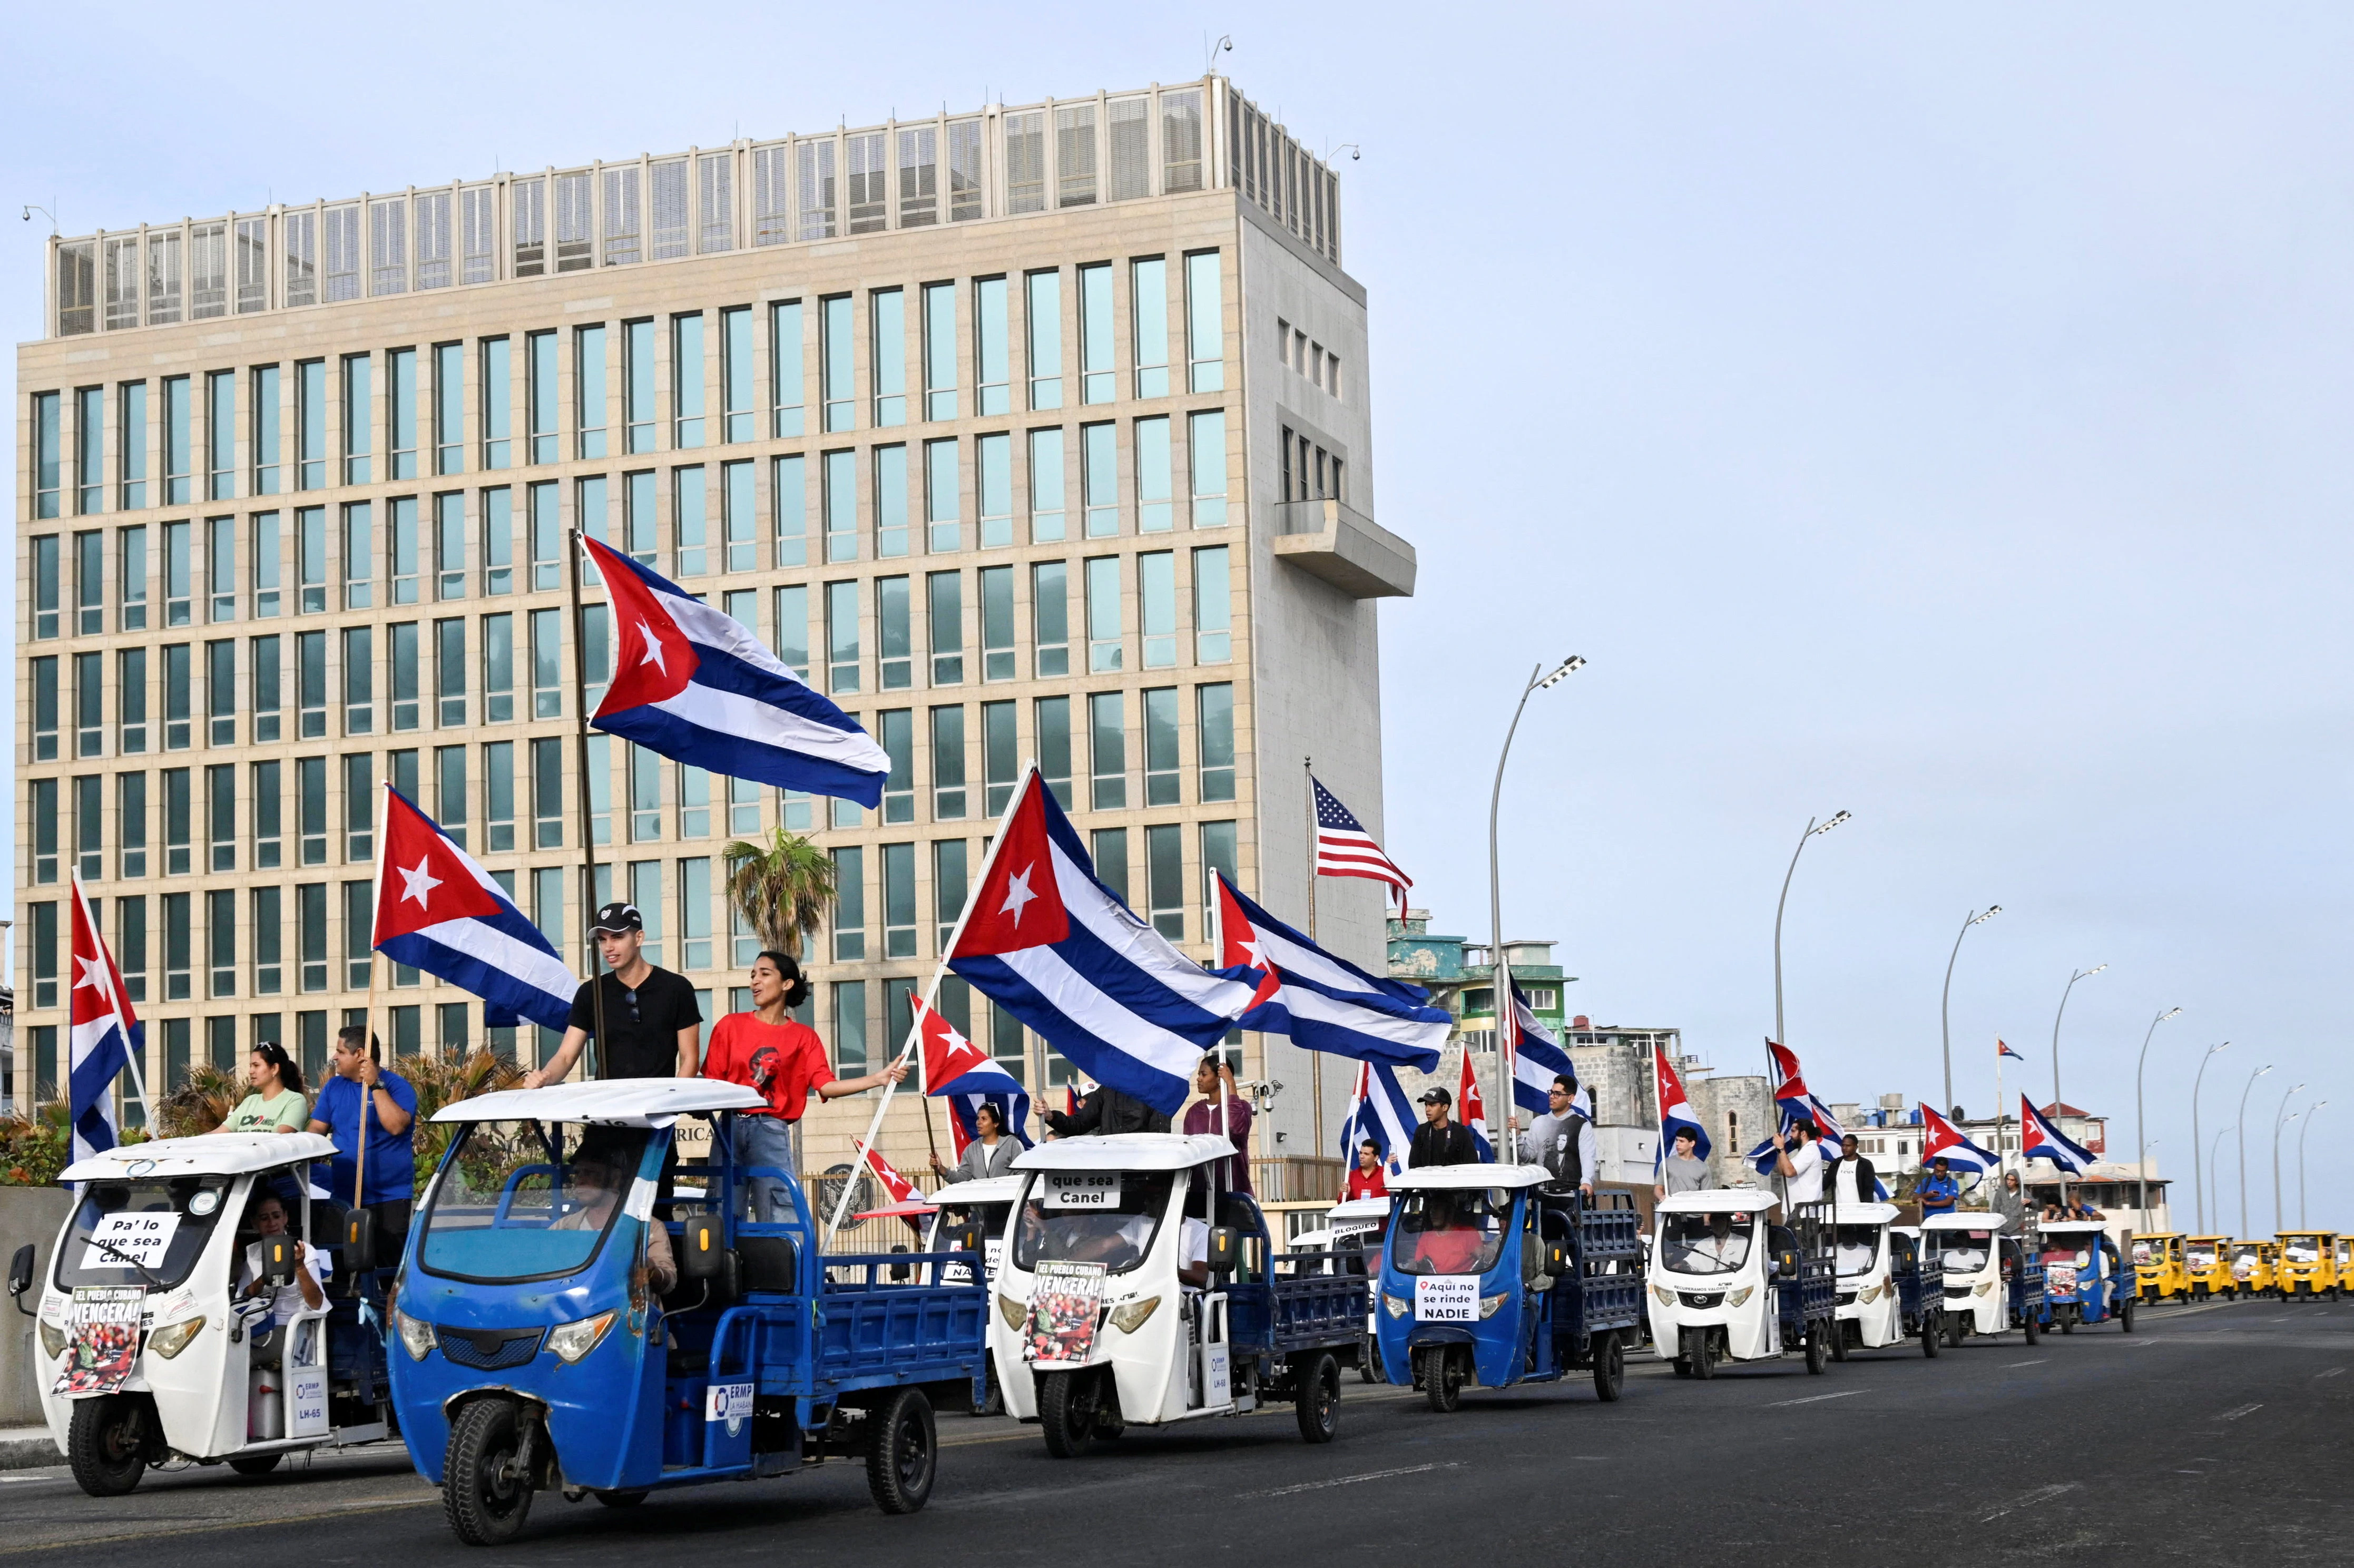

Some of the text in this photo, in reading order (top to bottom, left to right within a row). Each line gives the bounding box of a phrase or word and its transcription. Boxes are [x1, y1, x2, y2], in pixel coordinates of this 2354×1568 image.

[676, 1128, 714, 1142] RICA
[1053, 1177, 1113, 1189] que sea
[1061, 1191, 1105, 1203] Canel
[143, 1220, 159, 1230] lo
[1335, 1222, 1377, 1234] BLOQUEO
[97, 1238, 127, 1249] que
[100, 1251, 148, 1263] Canel
[1050, 1265, 1074, 1275] PUEBLO
[1075, 1267, 1102, 1276] CUBANO
[1036, 1275, 1101, 1296] VENCERÁ!
[1429, 1282, 1457, 1292] Aquí
[114, 1290, 142, 1300] CUBANO
[1440, 1295, 1470, 1303] rinde
[73, 1300, 138, 1324] VENCERÁ!
[1425, 1309, 1470, 1318] NADIE
[731, 1385, 752, 1398] ERMP
[299, 1408, 321, 1419] LH-65
